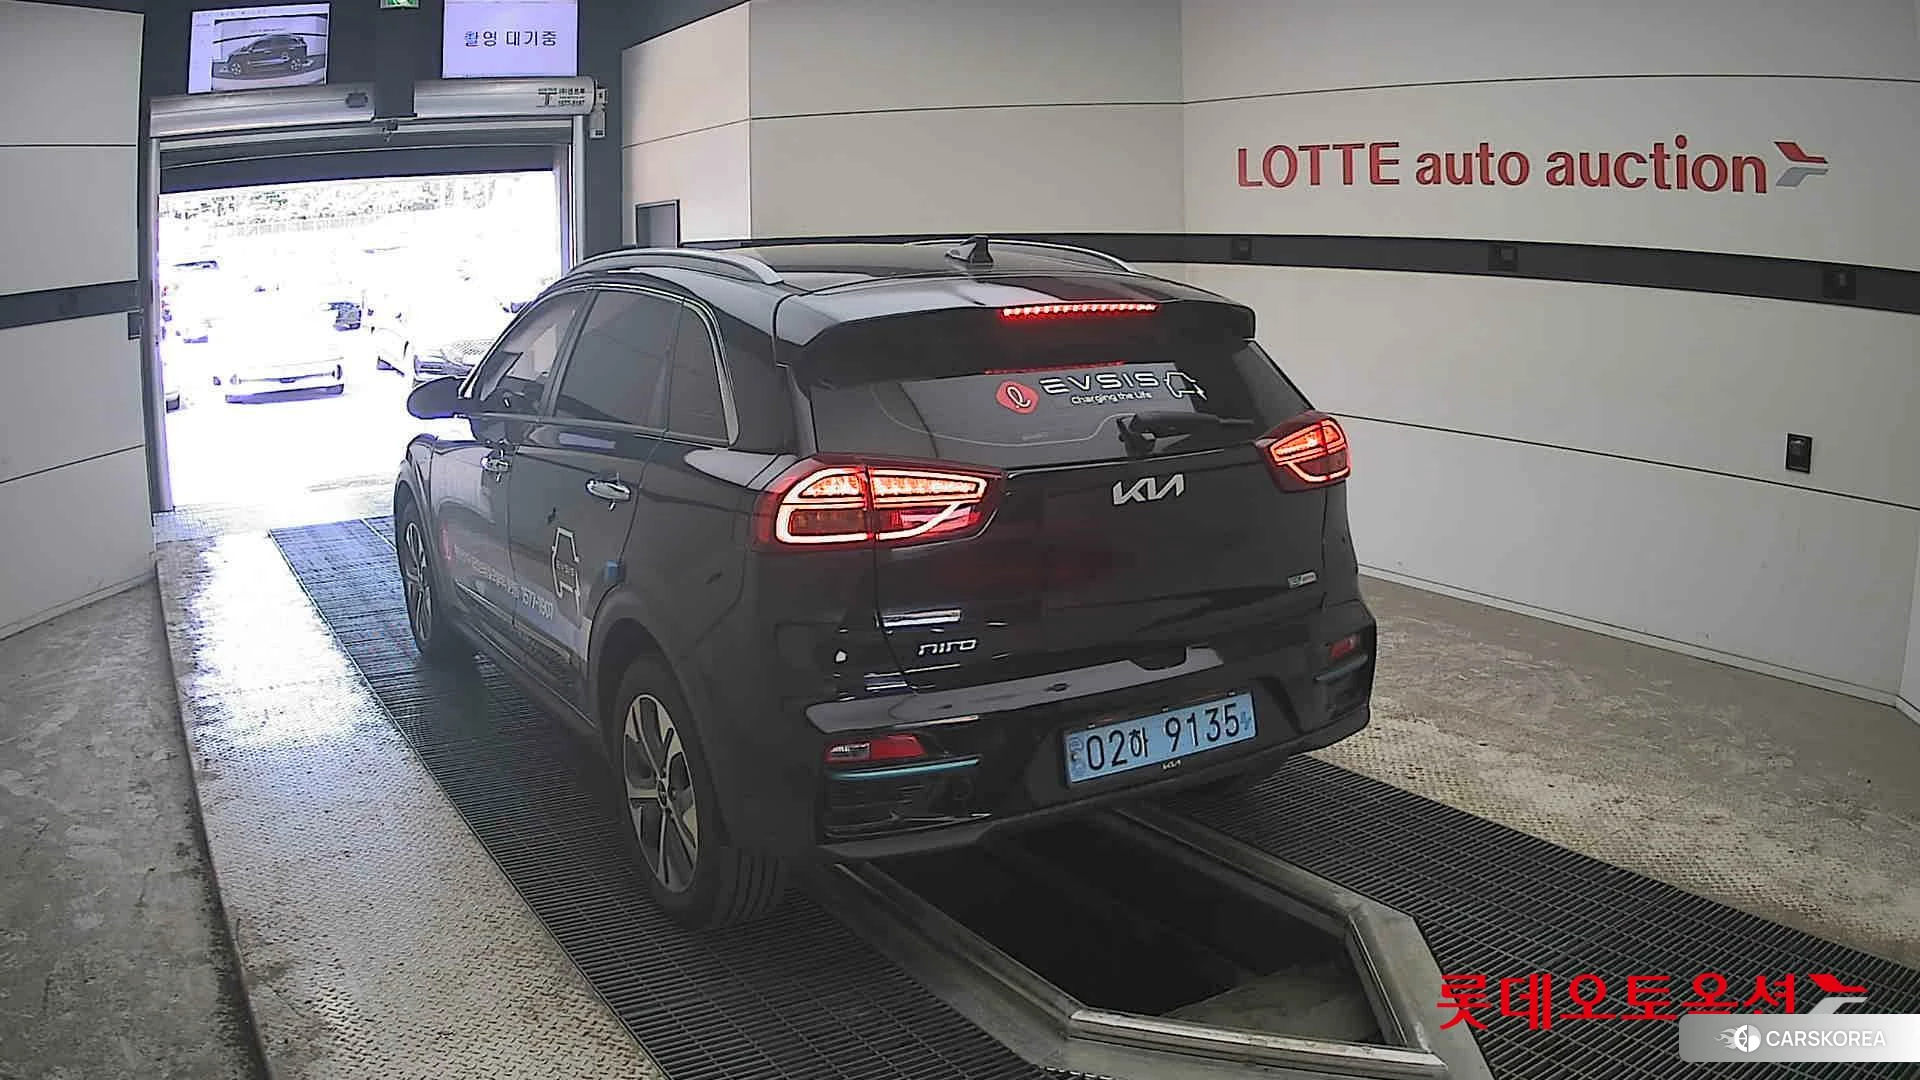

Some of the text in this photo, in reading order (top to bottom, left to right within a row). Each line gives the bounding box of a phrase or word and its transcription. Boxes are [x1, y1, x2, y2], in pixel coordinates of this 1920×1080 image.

[505, 30, 557, 47] 대기중
[1236, 134, 1768, 194] LOTTE auto auction
[1039, 372, 1159, 395] EVSIS
[1071, 392, 1118, 405] Charging
[1112, 473, 1185, 505] KIA
[1086, 703, 1240, 771] 02하 9135
